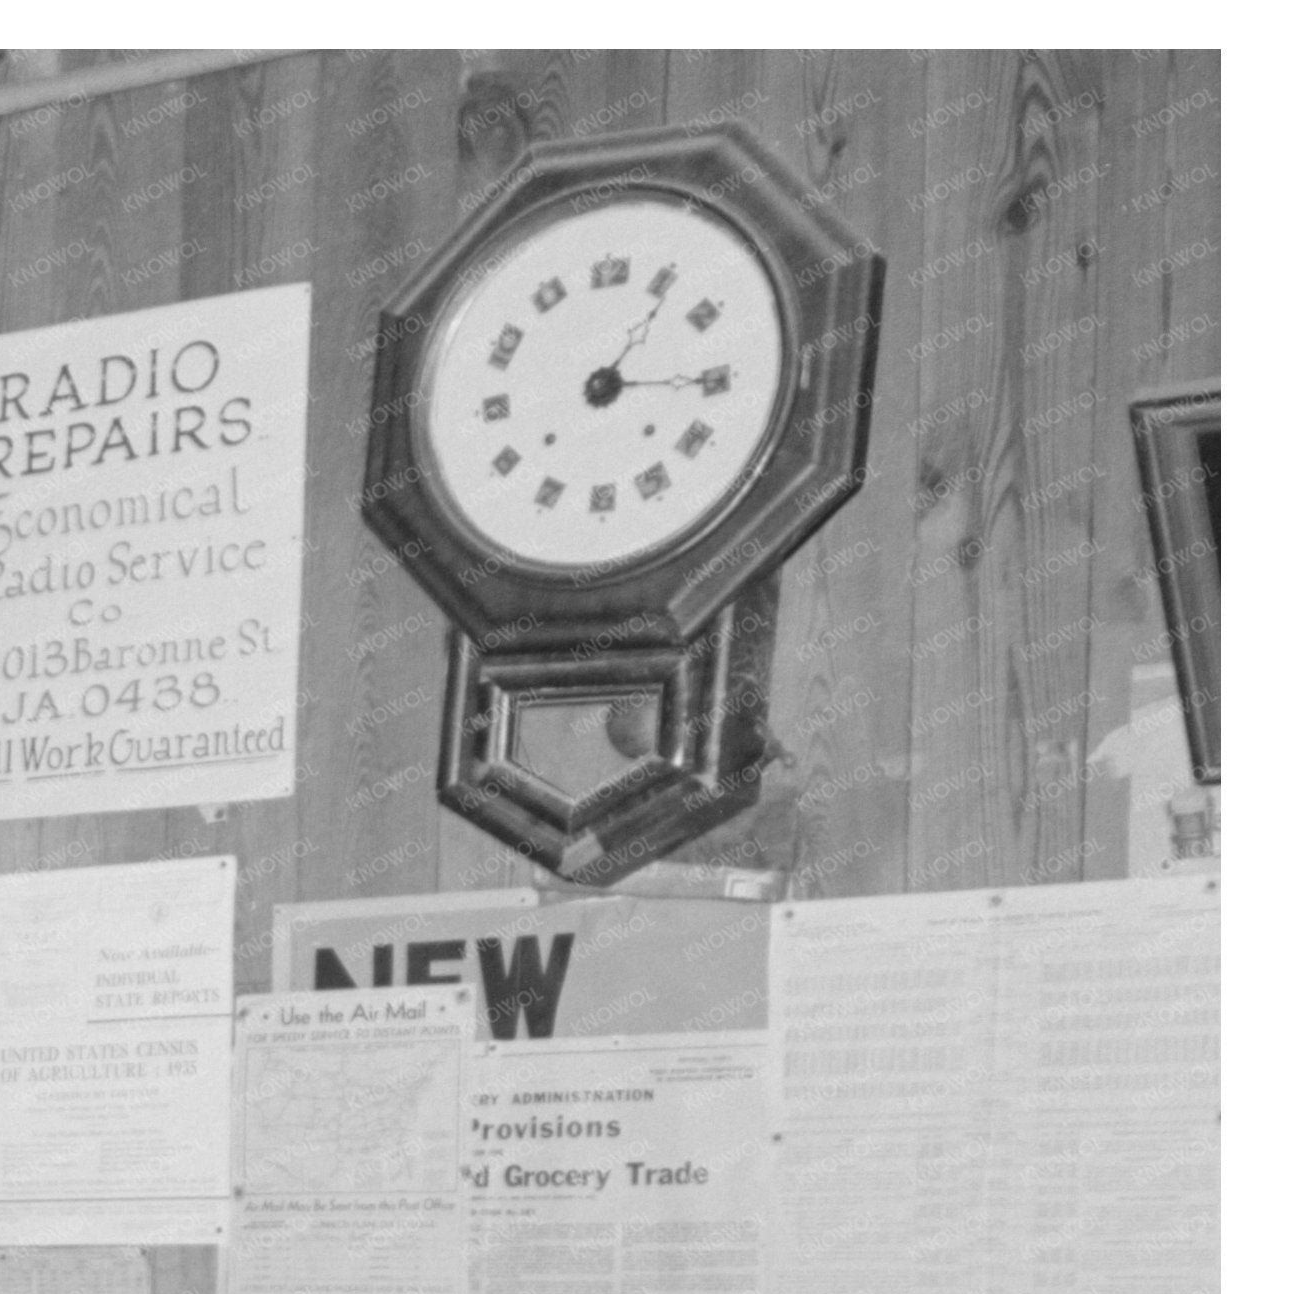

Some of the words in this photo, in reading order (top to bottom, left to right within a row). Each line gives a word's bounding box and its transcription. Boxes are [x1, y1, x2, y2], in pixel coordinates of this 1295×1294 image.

[109, 537, 267, 587] Service
[81, 673, 221, 718] 0438
[21, 732, 106, 773] Work
[110, 716, 286, 767] Guaranteed
[95, 971, 181, 988] INDIVIDUAL
[95, 989, 145, 1008] STATE
[280, 1007, 311, 1026] Use
[318, 1005, 344, 1023] the
[350, 1003, 378, 1021] Air
[385, 1000, 427, 1020] Mail
[0, 1046, 60, 1065] UNITED
[67, 1043, 128, 1061] STATES
[135, 1039, 199, 1058] CENSUS
[0, 1065, 21, 1083] OF
[27, 1061, 149, 1083] AGRICULTURE
[511, 1089, 655, 1106] ADMINISTRATION
[504, 1164, 611, 1191] Grocery
[626, 1160, 709, 1187] Trade
